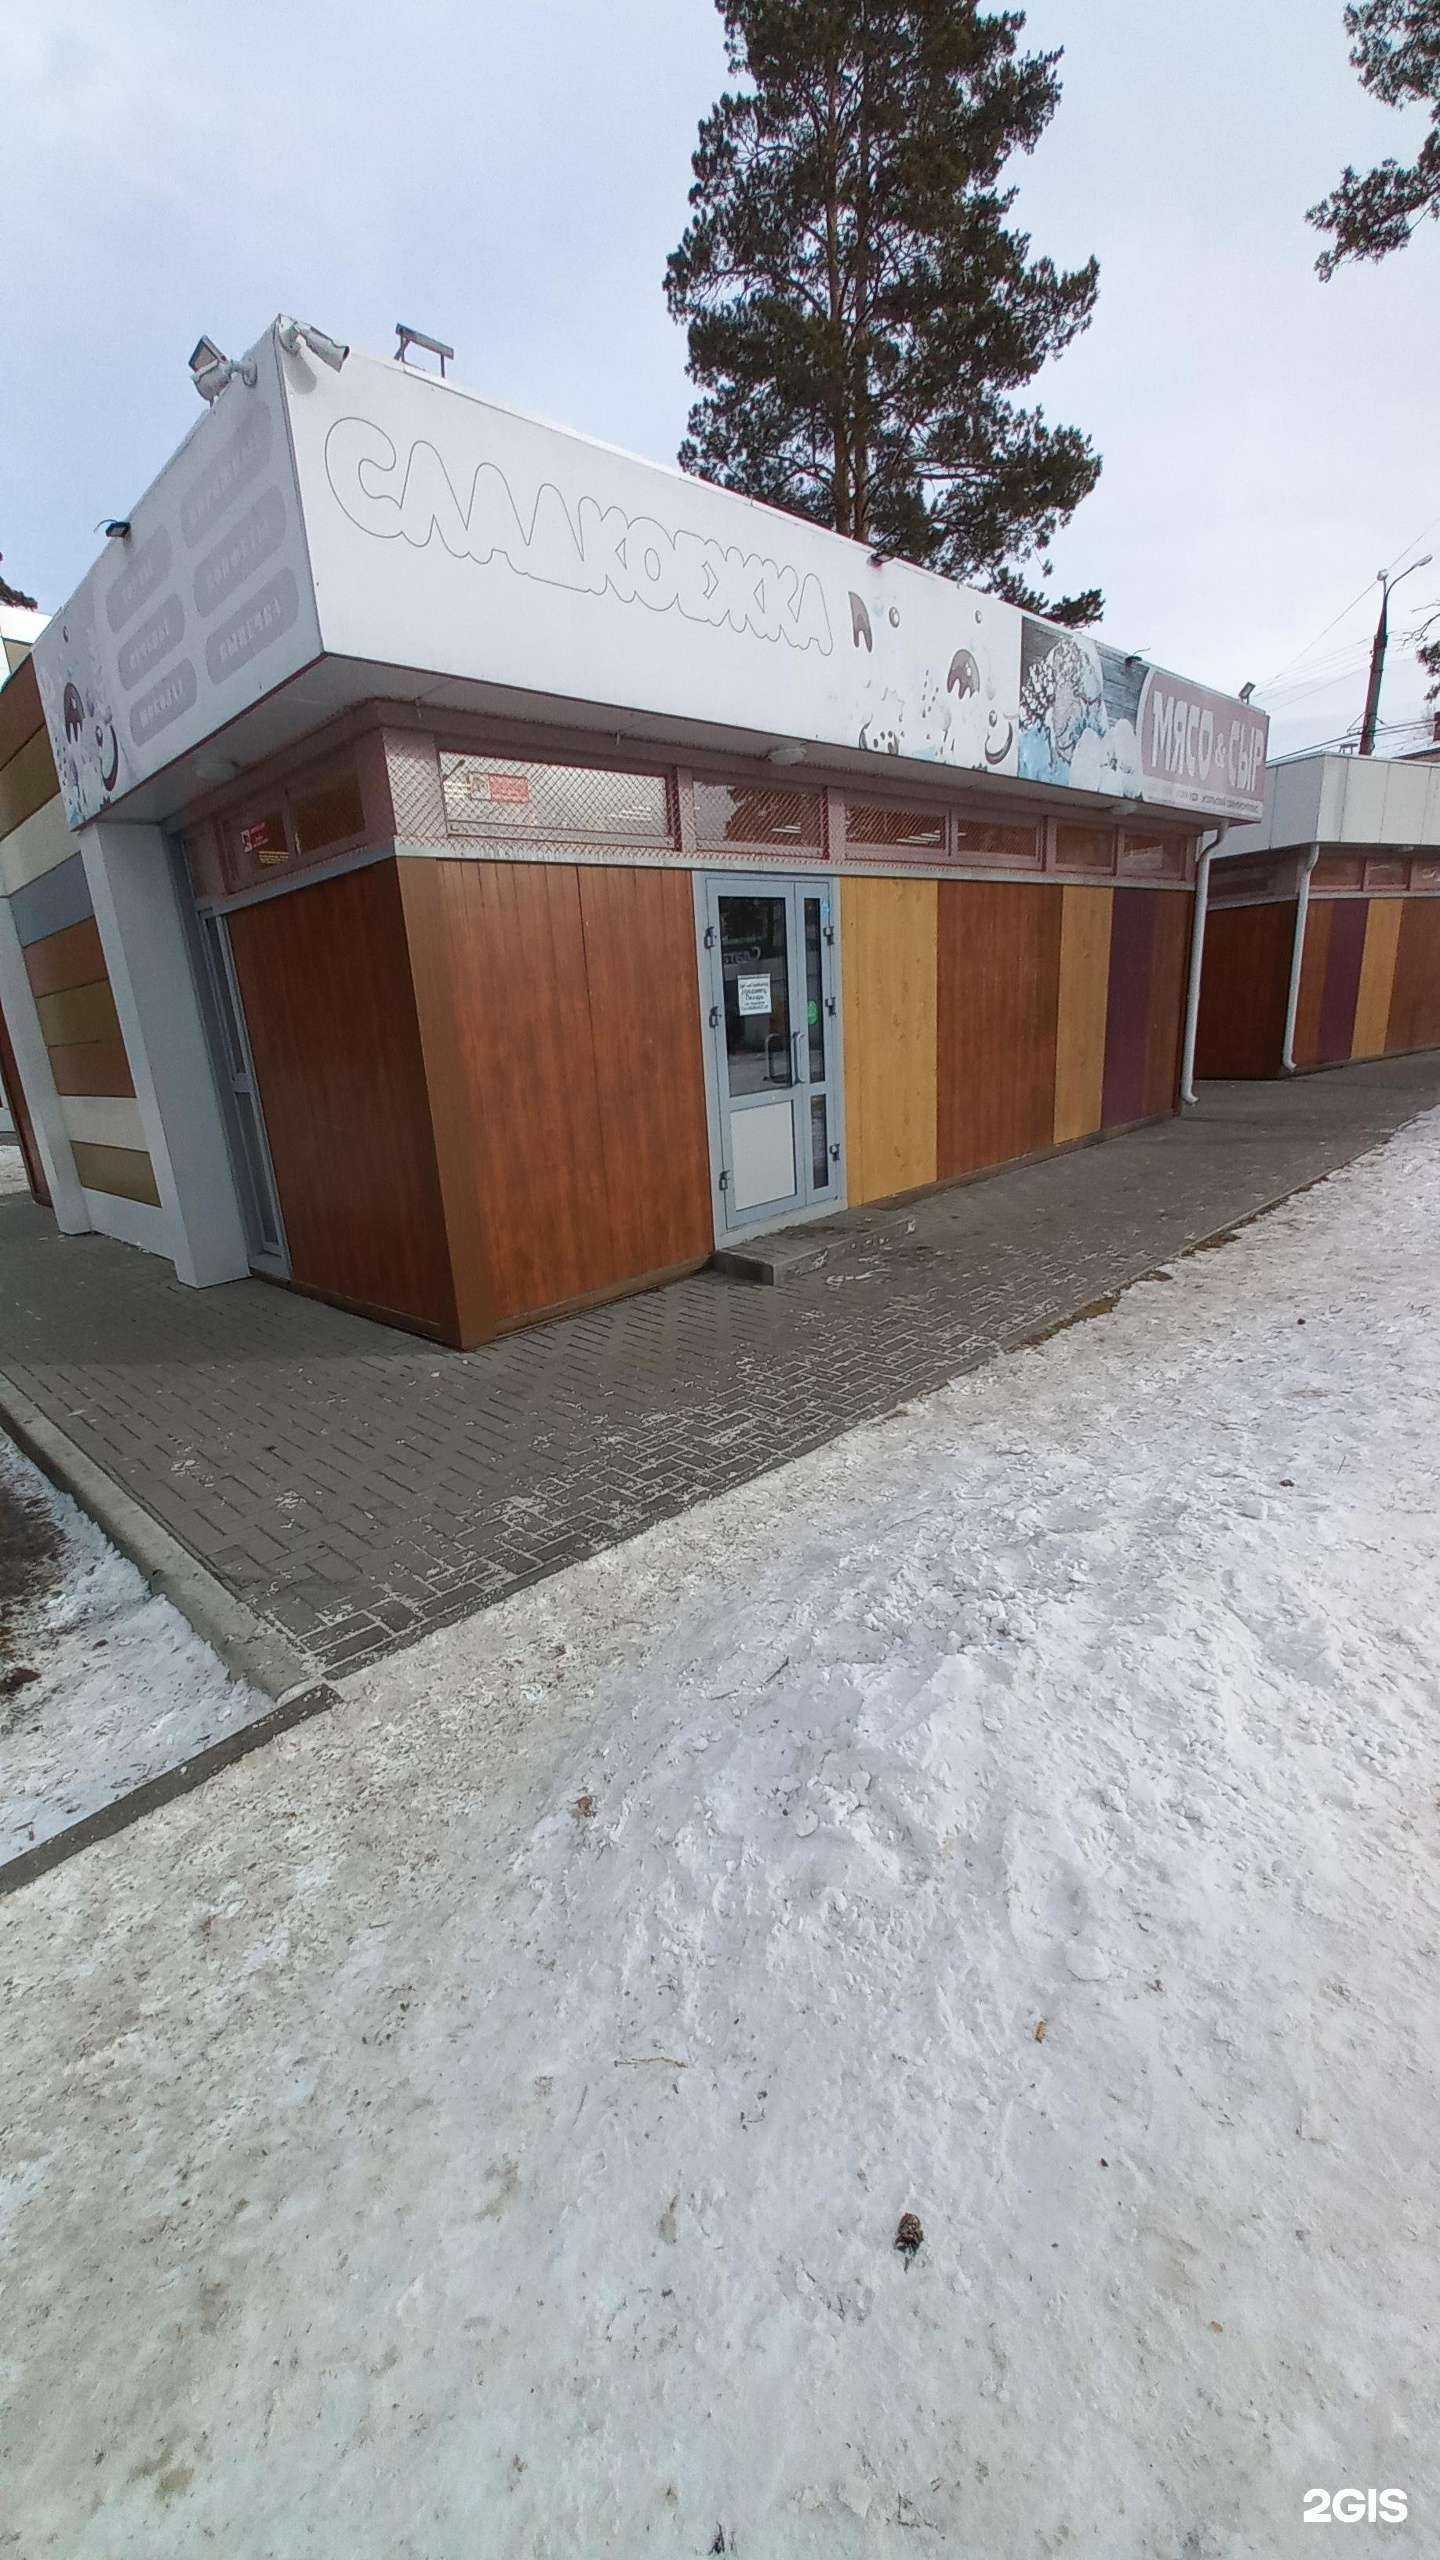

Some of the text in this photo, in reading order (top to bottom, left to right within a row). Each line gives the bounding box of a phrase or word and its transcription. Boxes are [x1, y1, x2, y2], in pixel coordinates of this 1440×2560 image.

[1151, 689, 1265, 793] МЯСО & СЫР
